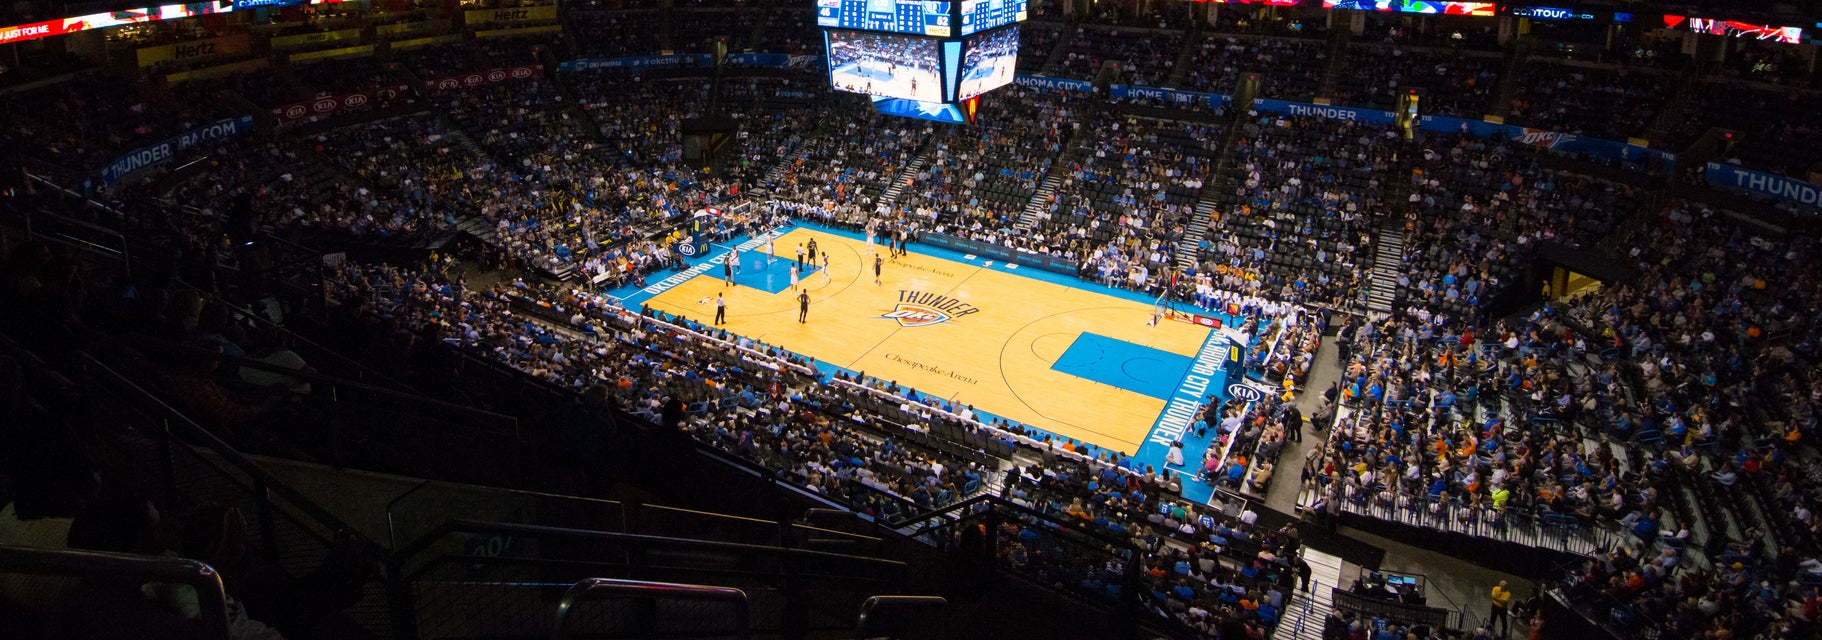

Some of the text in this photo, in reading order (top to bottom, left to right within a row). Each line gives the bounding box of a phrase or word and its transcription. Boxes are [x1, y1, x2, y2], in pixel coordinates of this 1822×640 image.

[494, 10, 528, 20] Hertz
[4, 30, 21, 39] JUST
[22, 26, 38, 36] FOR
[175, 42, 216, 58] Hertz
[1059, 81, 1083, 91] CITY
[1128, 88, 1162, 100] HOME
[1288, 104, 1356, 120] THUNDER
[1734, 170, 1822, 207] THUND
[681, 245, 693, 254] KIA
[645, 263, 715, 294] OKLAHOMA
[898, 290, 980, 318] THUNDER
[885, 353, 978, 385] Chesapeake Arena
[1149, 330, 1231, 447] OKLAHOMA CITY THUNDER
[1234, 386, 1255, 399] KIA
